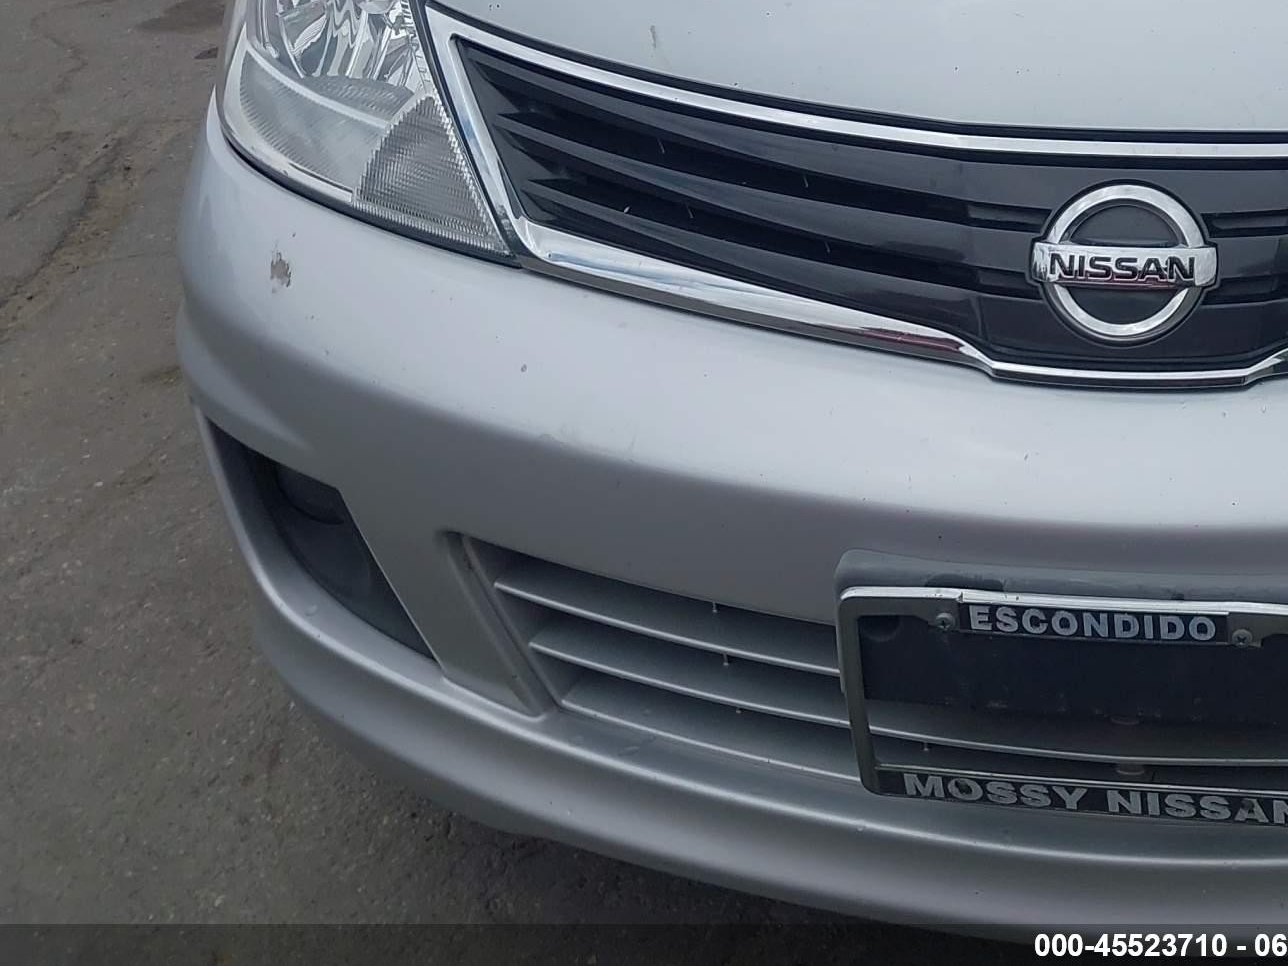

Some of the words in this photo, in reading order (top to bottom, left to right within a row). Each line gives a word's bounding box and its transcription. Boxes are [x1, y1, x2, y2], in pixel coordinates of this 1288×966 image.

[1049, 251, 1196, 282] NISSAN
[968, 603, 1217, 642] ESCONDIDO
[902, 772, 1088, 812] MOSSY
